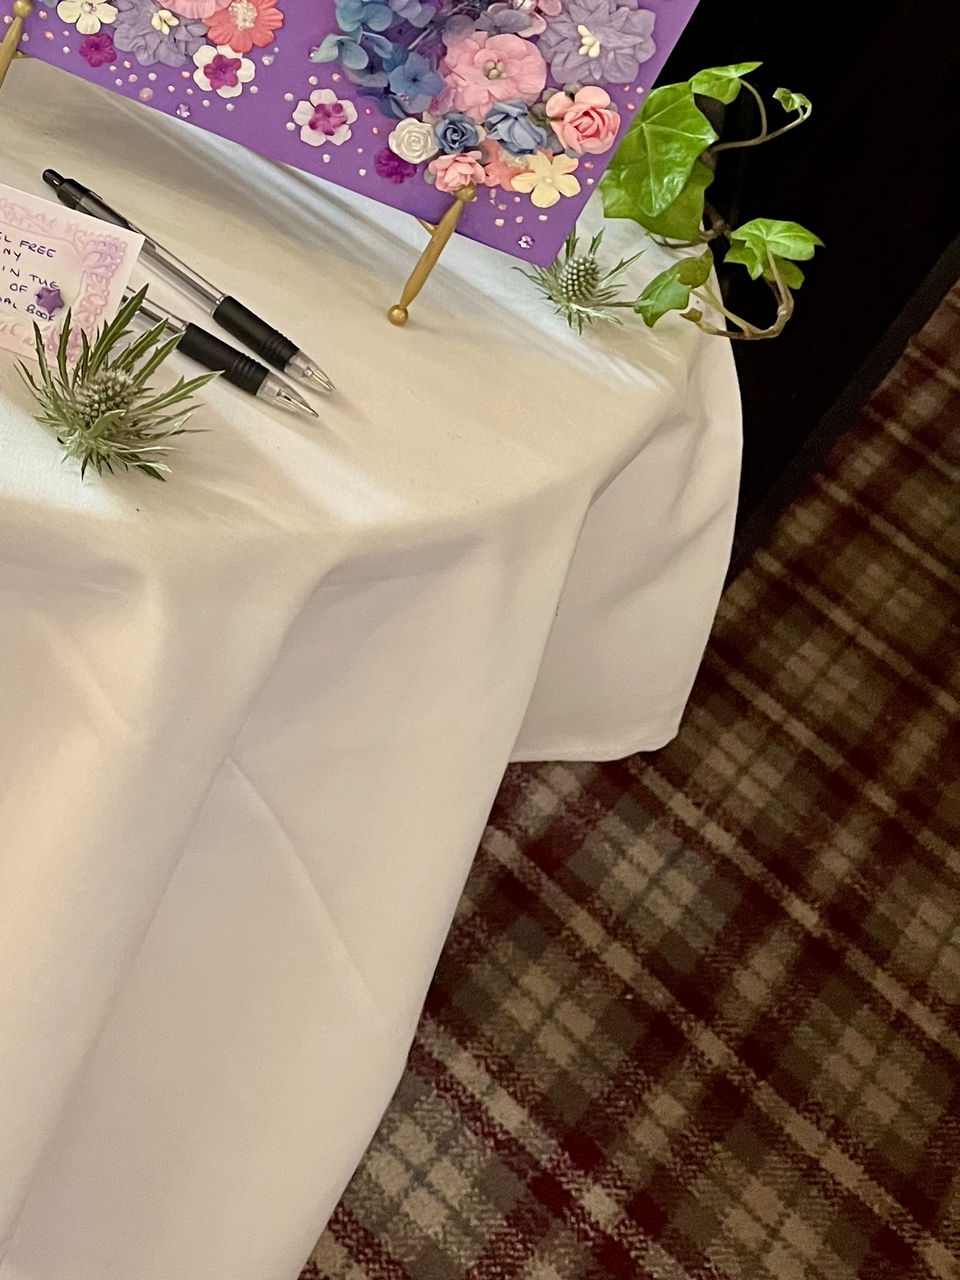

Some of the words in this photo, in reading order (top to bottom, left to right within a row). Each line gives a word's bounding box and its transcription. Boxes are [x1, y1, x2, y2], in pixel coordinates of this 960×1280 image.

[19, 240, 57, 258] FREE
[2, 265, 21, 278] IN
[9, 283, 28, 293] OF
[25, 303, 56, 322] BOOK
